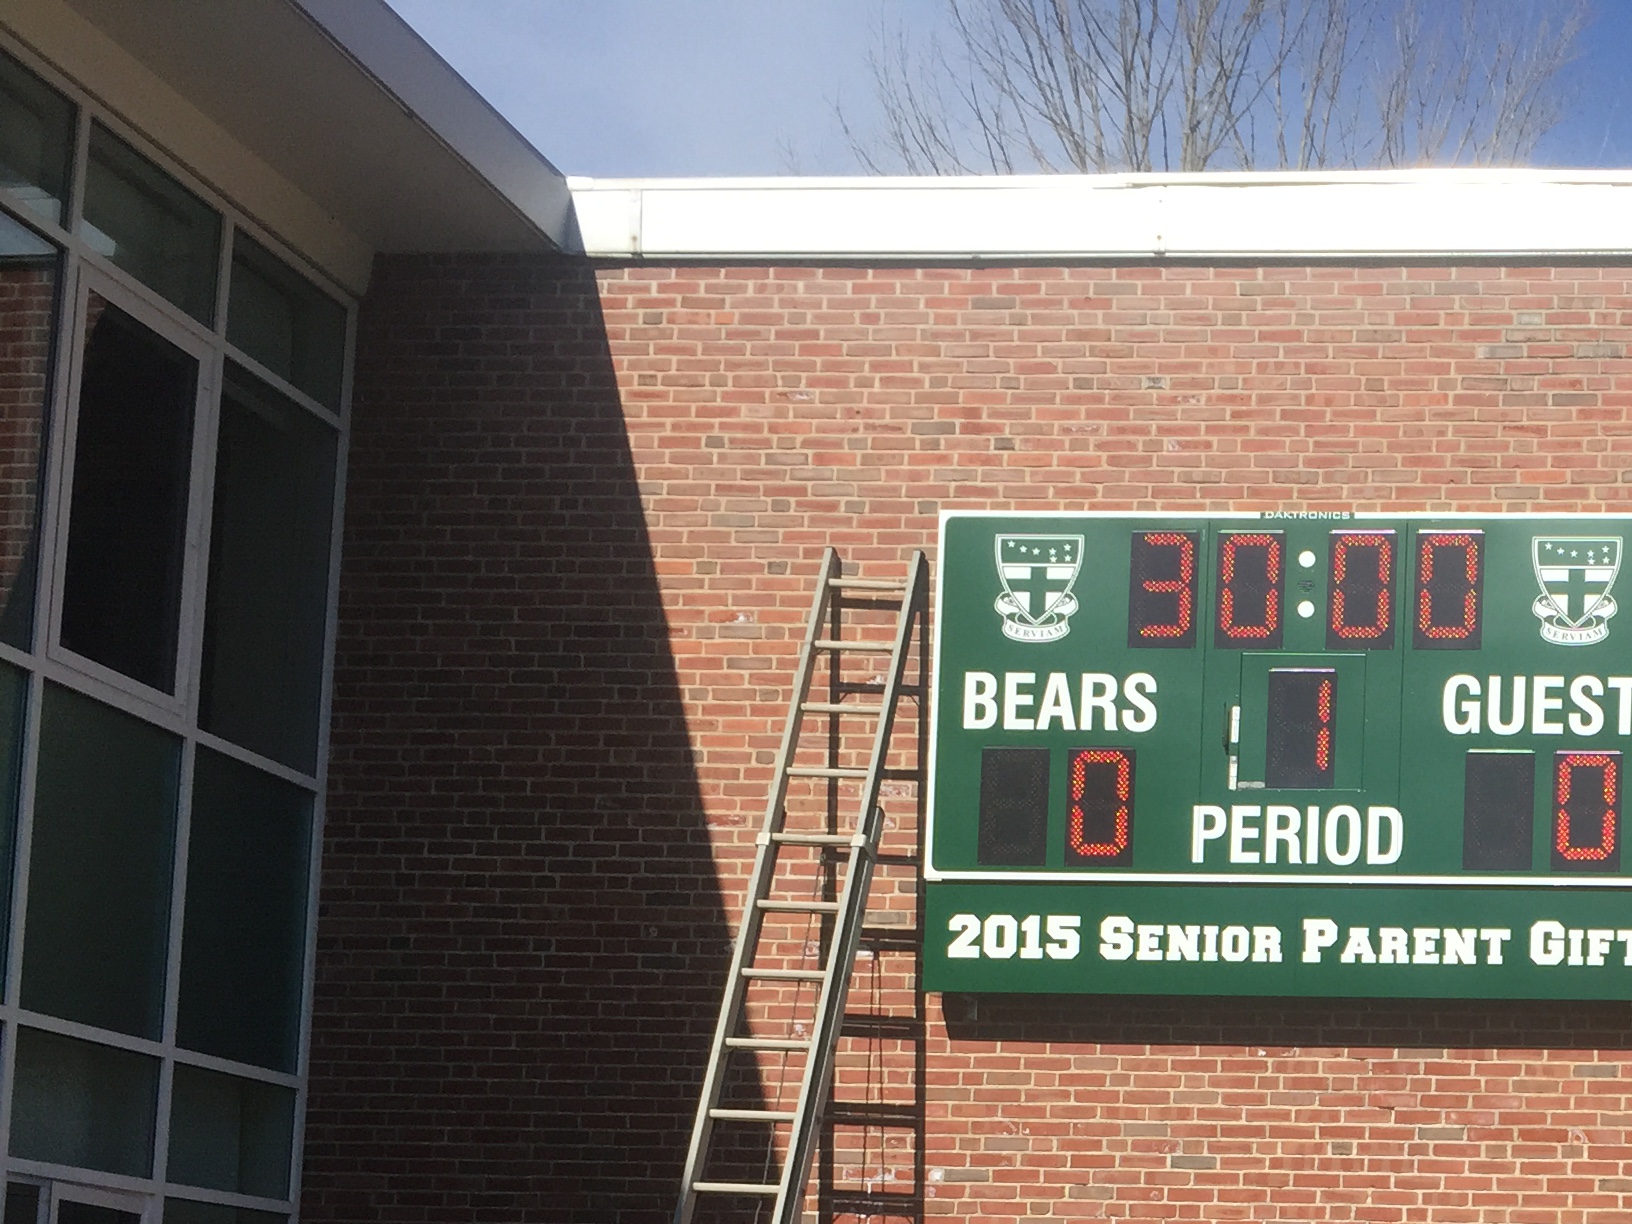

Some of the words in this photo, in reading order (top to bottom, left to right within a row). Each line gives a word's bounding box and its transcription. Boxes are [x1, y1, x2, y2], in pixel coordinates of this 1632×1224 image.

[1264, 511, 1350, 520] DAKTRONICS
[1008, 624, 1064, 638] SERVIAM
[1546, 627, 1603, 640] SERVIAM
[962, 672, 1158, 731] BEARS
[1316, 679, 1331, 771] 1
[1070, 750, 1128, 856] 0
[1557, 755, 1616, 861] 0
[1191, 805, 1403, 865] PERIOD
[947, 914, 1081, 960] 2015
